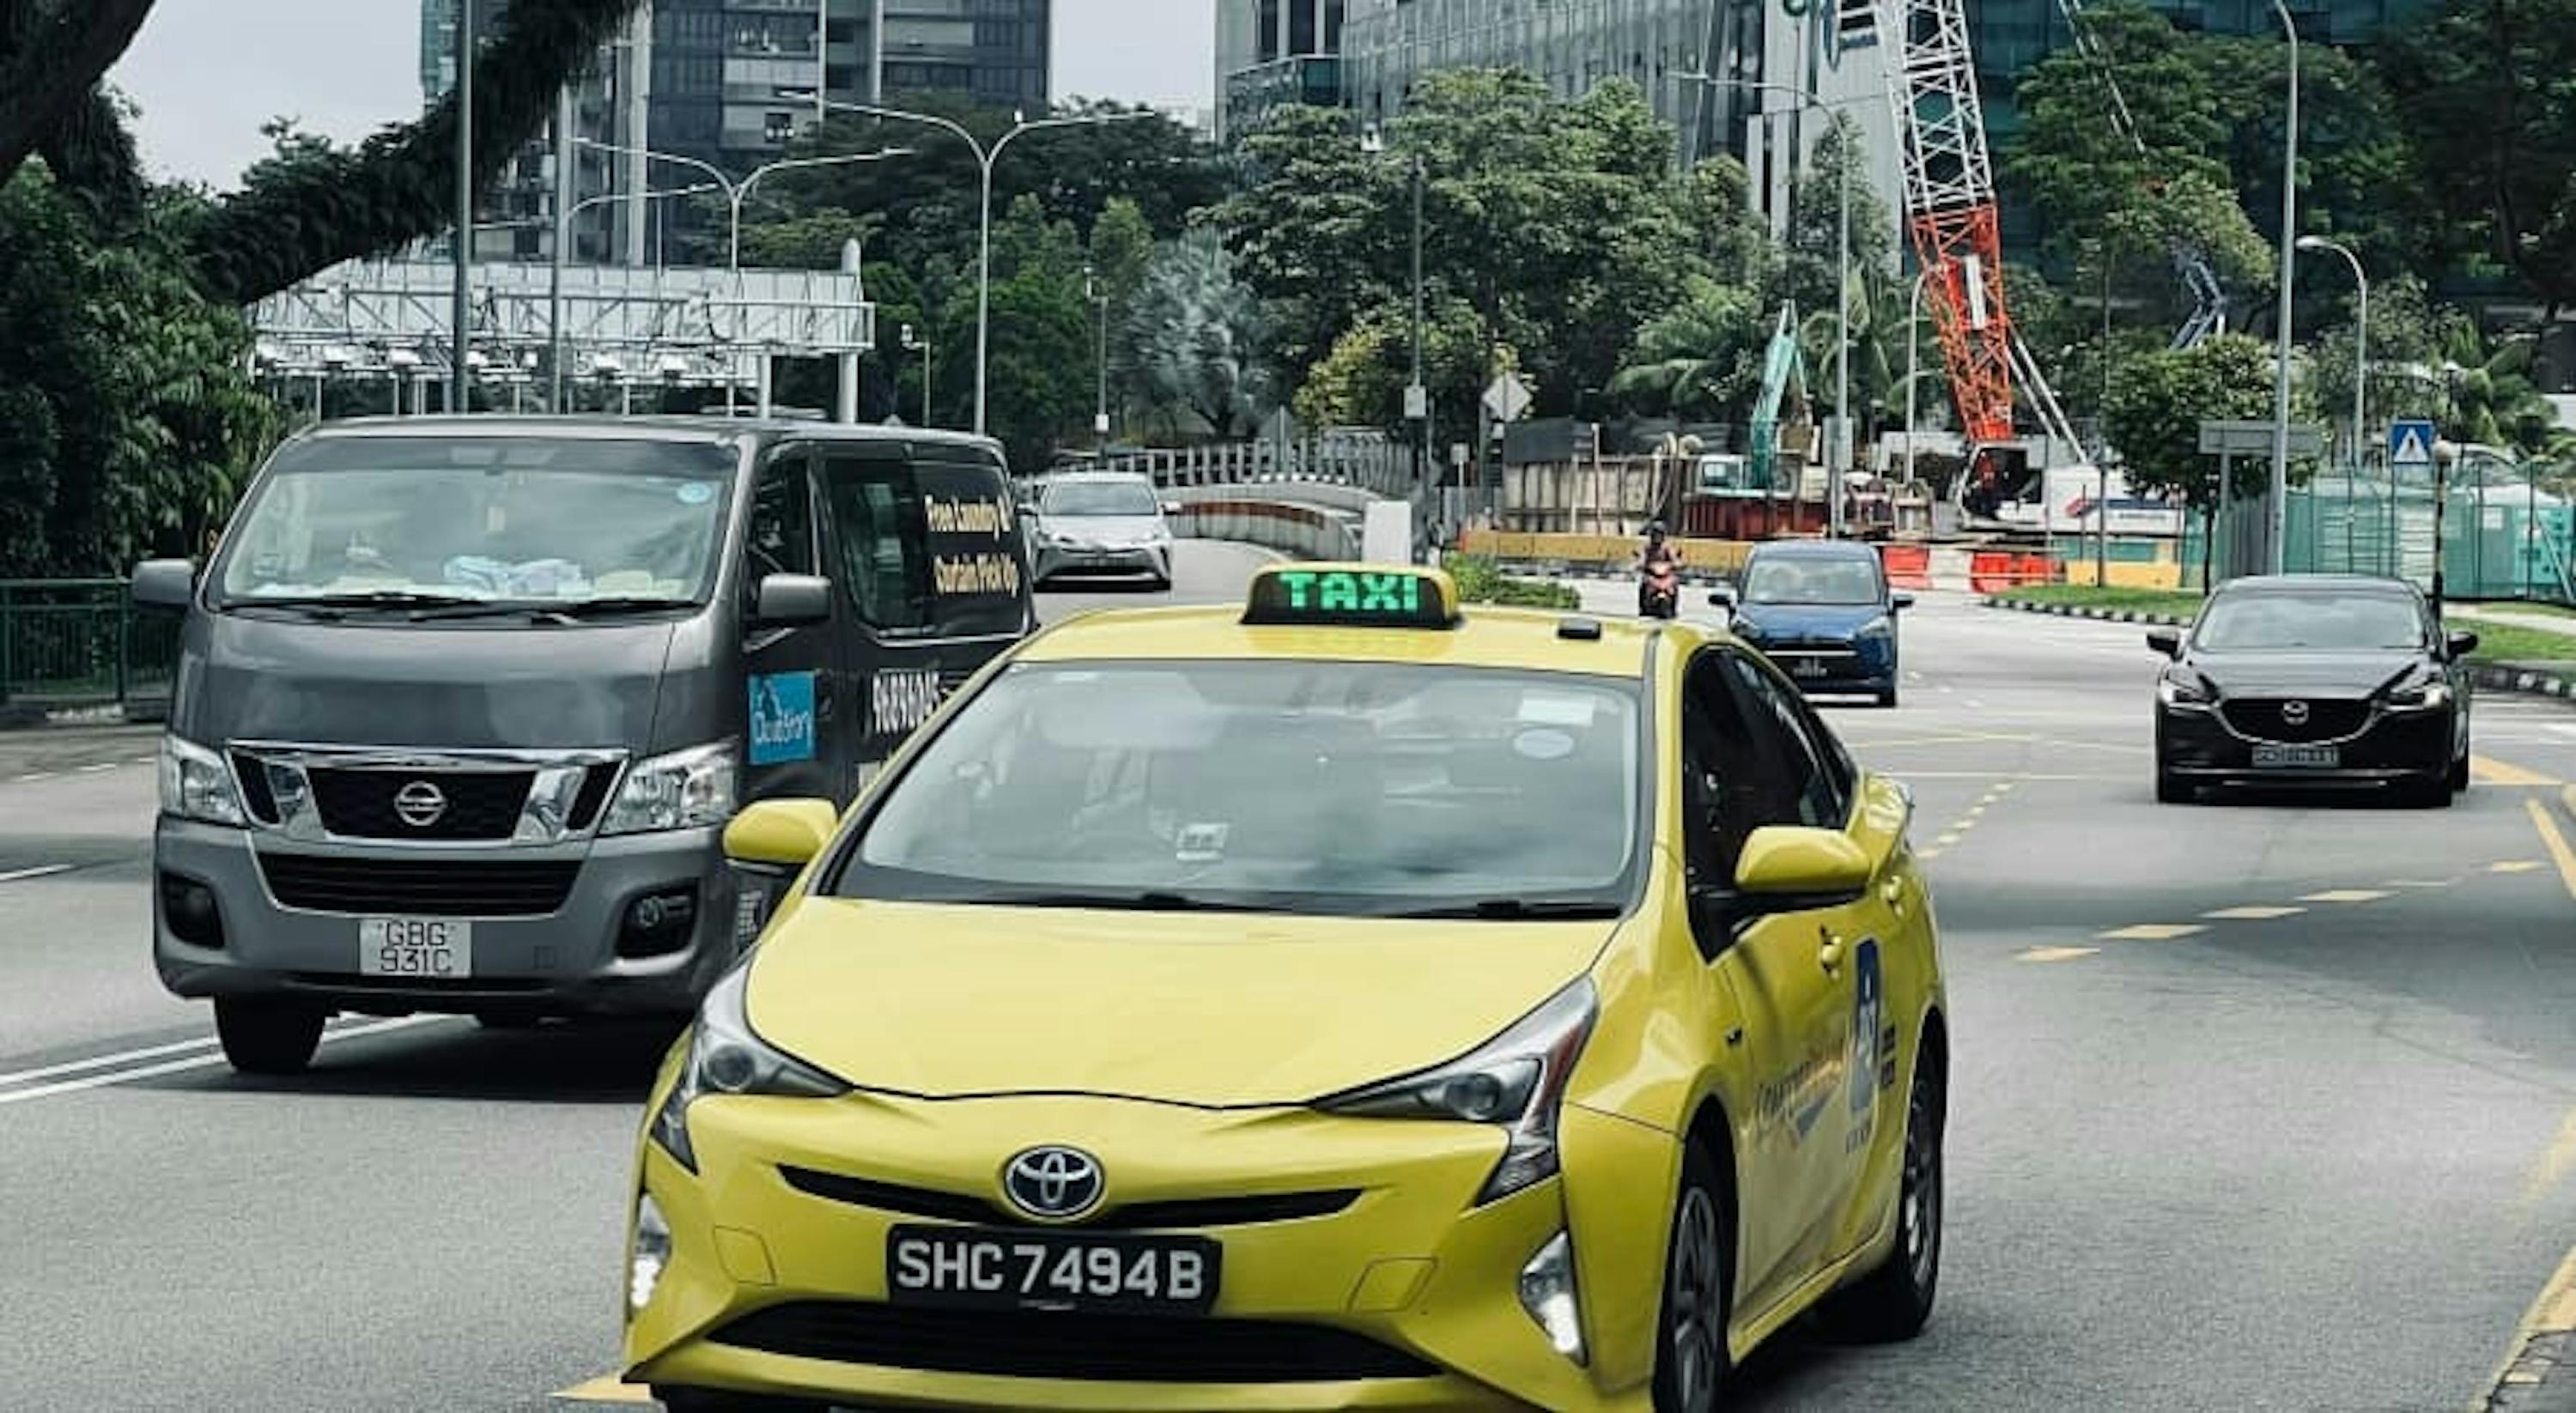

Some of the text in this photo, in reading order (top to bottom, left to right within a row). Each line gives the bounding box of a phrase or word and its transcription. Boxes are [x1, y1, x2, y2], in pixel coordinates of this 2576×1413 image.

[925, 494, 955, 532] Free
[952, 494, 999, 542] Laundry
[933, 553, 1018, 598] Curtain Pick Up
[1279, 573, 1418, 610] TAXI
[387, 920, 445, 945] GBG
[381, 949, 451, 972] 931C
